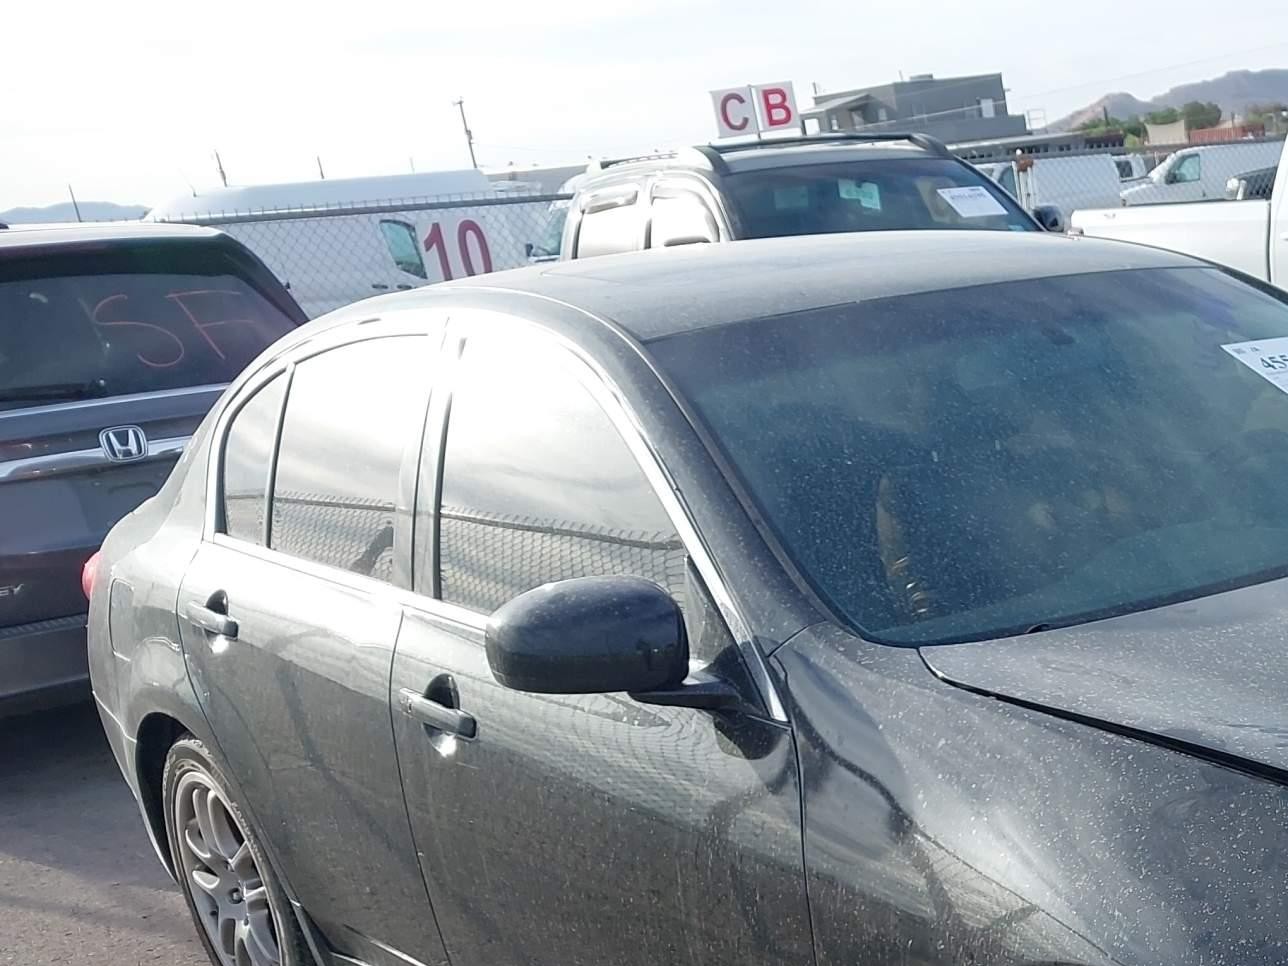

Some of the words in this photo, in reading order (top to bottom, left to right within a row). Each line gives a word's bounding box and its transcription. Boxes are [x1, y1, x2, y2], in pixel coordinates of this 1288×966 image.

[721, 92, 749, 130] C
[762, 88, 792, 127] B
[424, 219, 493, 281] 10
